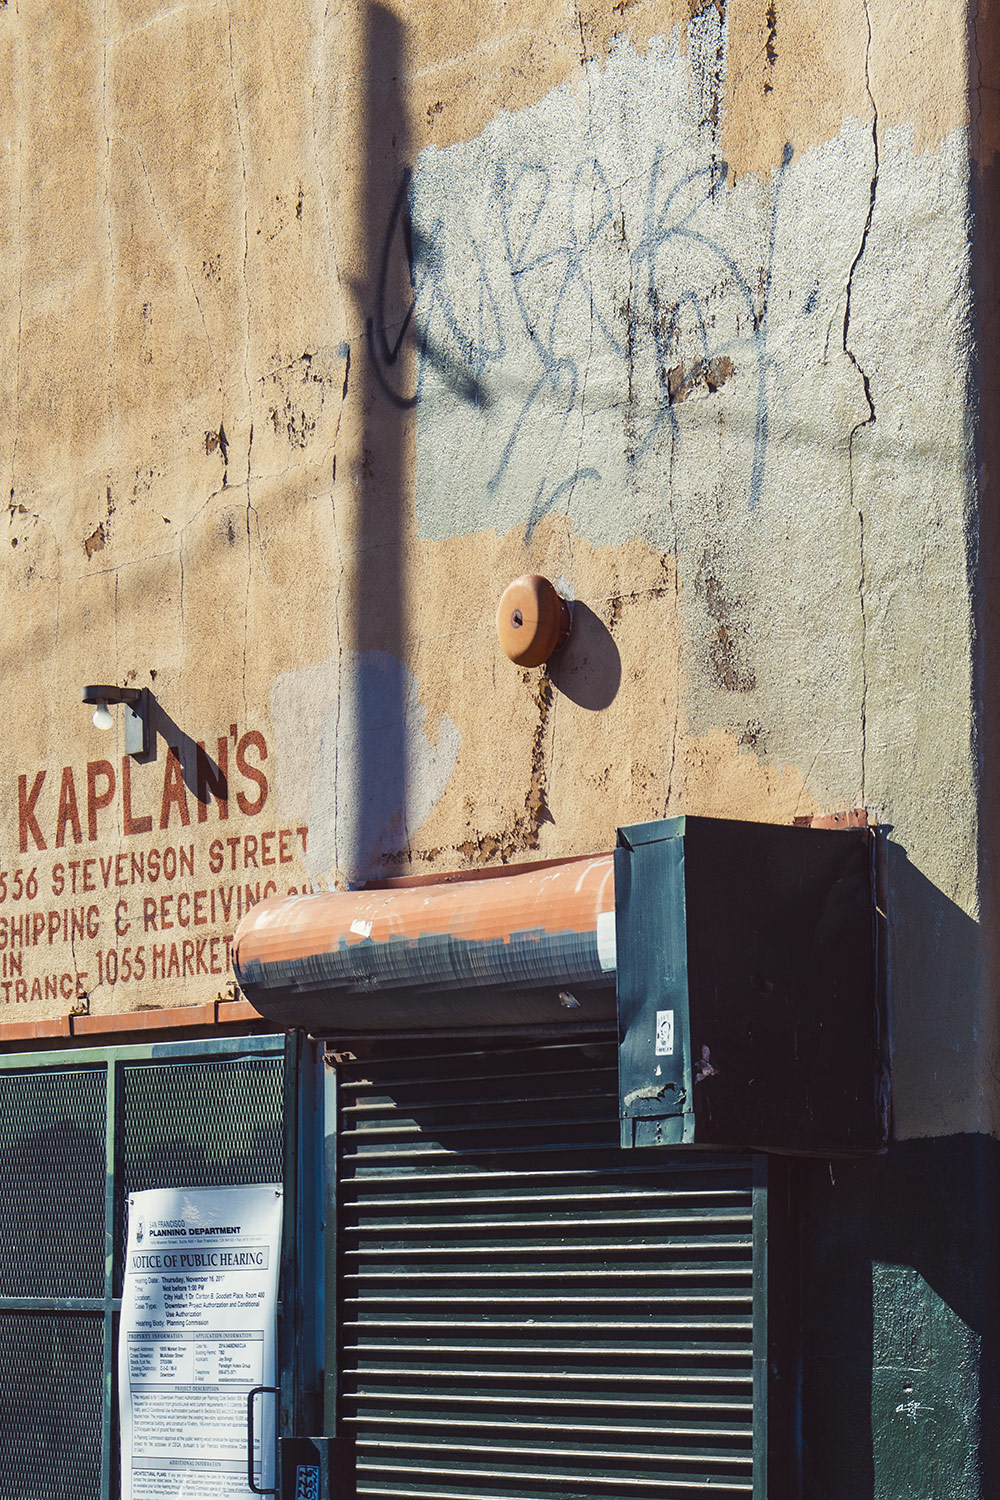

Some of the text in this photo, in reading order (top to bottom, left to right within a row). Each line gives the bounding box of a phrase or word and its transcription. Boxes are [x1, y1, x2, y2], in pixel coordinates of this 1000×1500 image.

[17, 723, 269, 854] KAPLAN'S
[51, 844, 195, 897] STEVENSON
[208, 826, 309, 875] STREET
[0, 904, 100, 950] SHIPPING
[115, 899, 132, 937] &
[96, 934, 235, 986] 1055 MARKET
[149, 1219, 186, 1229] SAN FRANCISCO
[149, 1226, 241, 1237] PLANNING DEPARTMENT
[132, 1251, 263, 1269] NOTICE OF PUBLIC HEARING
[161, 1276, 185, 1284] Thursday,
[186, 1275, 208, 1283] November
[164, 1294, 173, 1302] City
